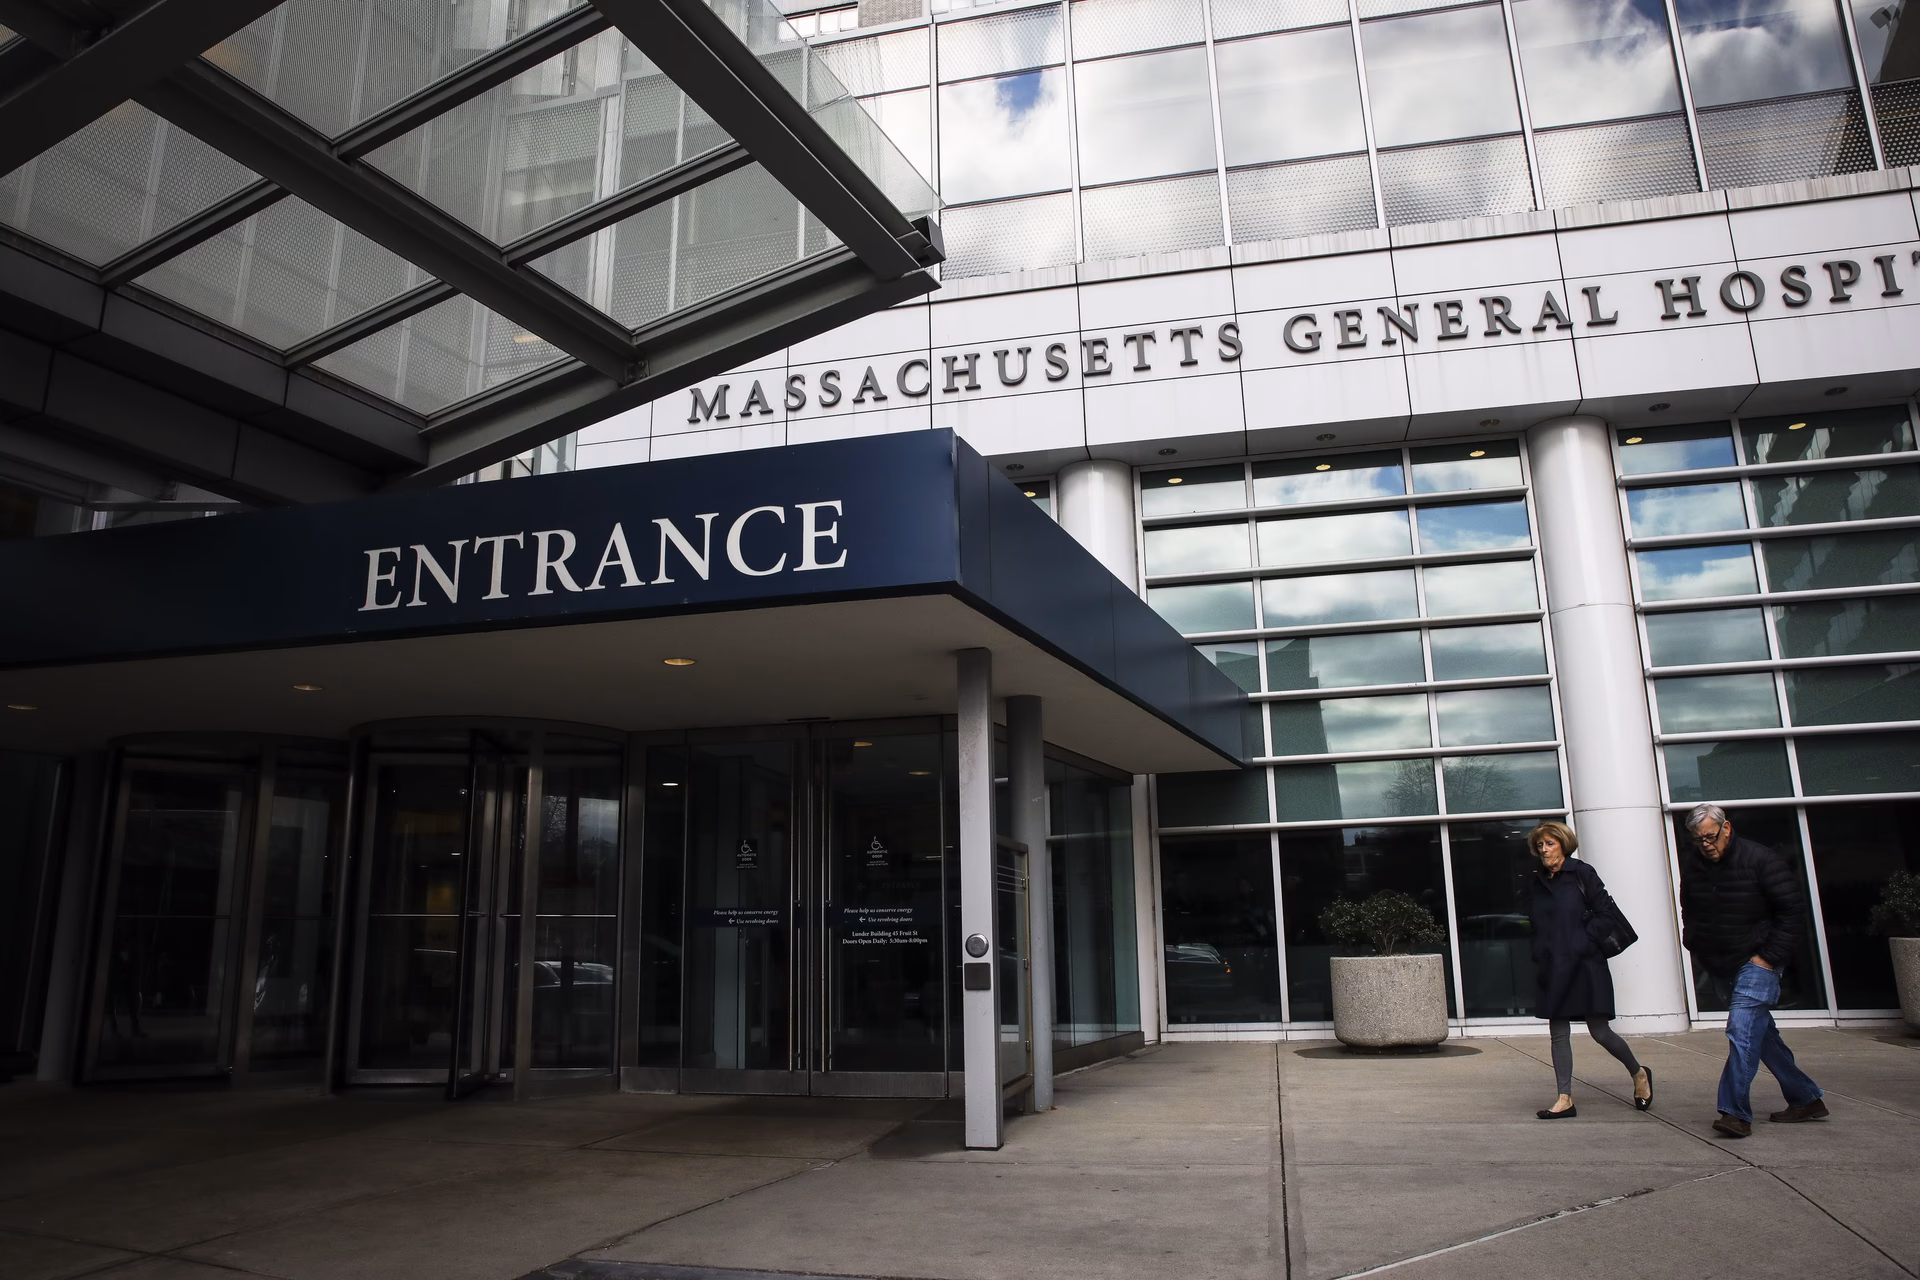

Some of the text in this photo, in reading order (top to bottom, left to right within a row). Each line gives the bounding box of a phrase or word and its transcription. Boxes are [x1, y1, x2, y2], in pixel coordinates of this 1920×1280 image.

[687, 250, 1920, 423] MASSACHUSETTS GENERAL HOSPI
[357, 500, 848, 611] ENTRANCE
[859, 907, 869, 915] help
[870, 930, 892, 938] Building
